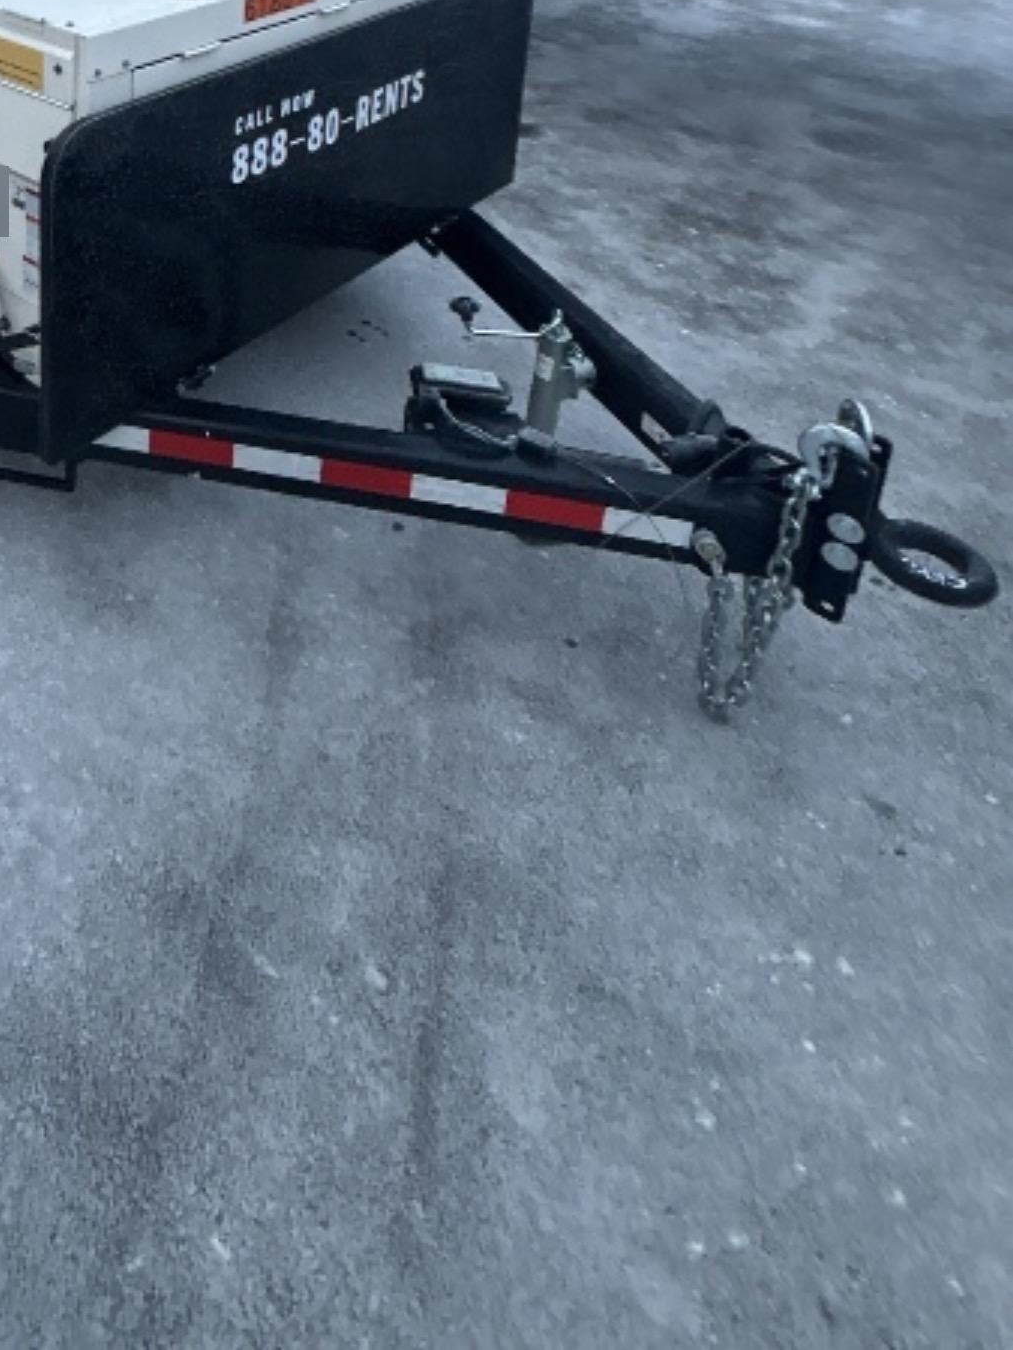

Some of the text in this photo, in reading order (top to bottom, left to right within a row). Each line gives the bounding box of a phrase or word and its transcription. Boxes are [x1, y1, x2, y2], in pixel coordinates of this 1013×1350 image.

[231, 68, 426, 185] 888-80-RENTS
[235, 88, 316, 136] CALL NOW
